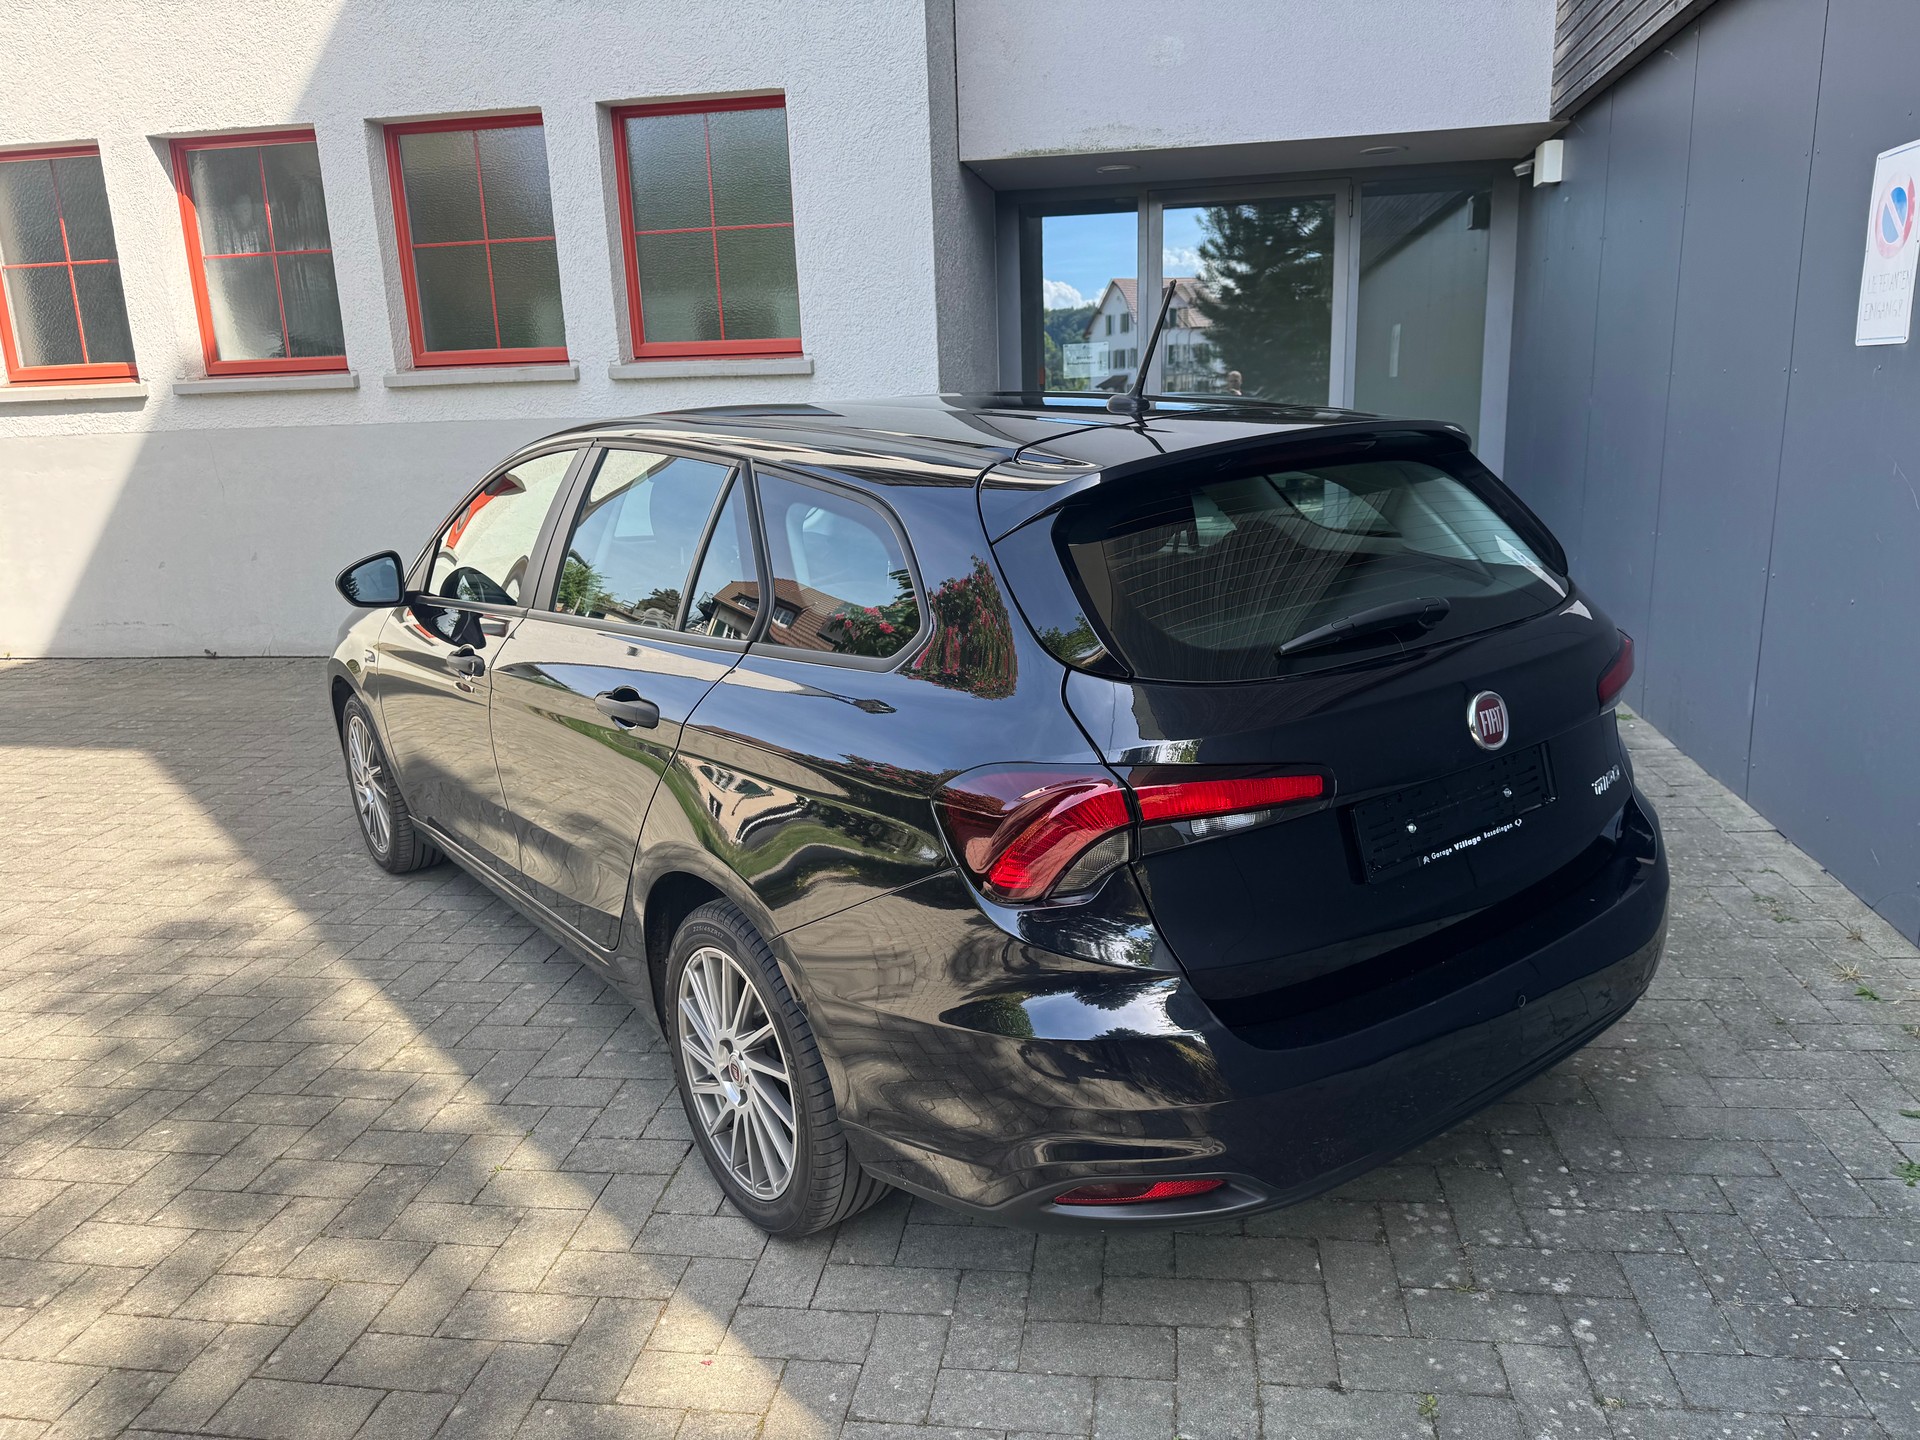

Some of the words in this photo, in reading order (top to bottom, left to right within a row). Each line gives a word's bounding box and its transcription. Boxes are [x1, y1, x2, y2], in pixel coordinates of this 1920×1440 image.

[1479, 705, 1503, 737] FIAT
[1431, 847, 1453, 860] Garage
[1453, 835, 1482, 851] Village
